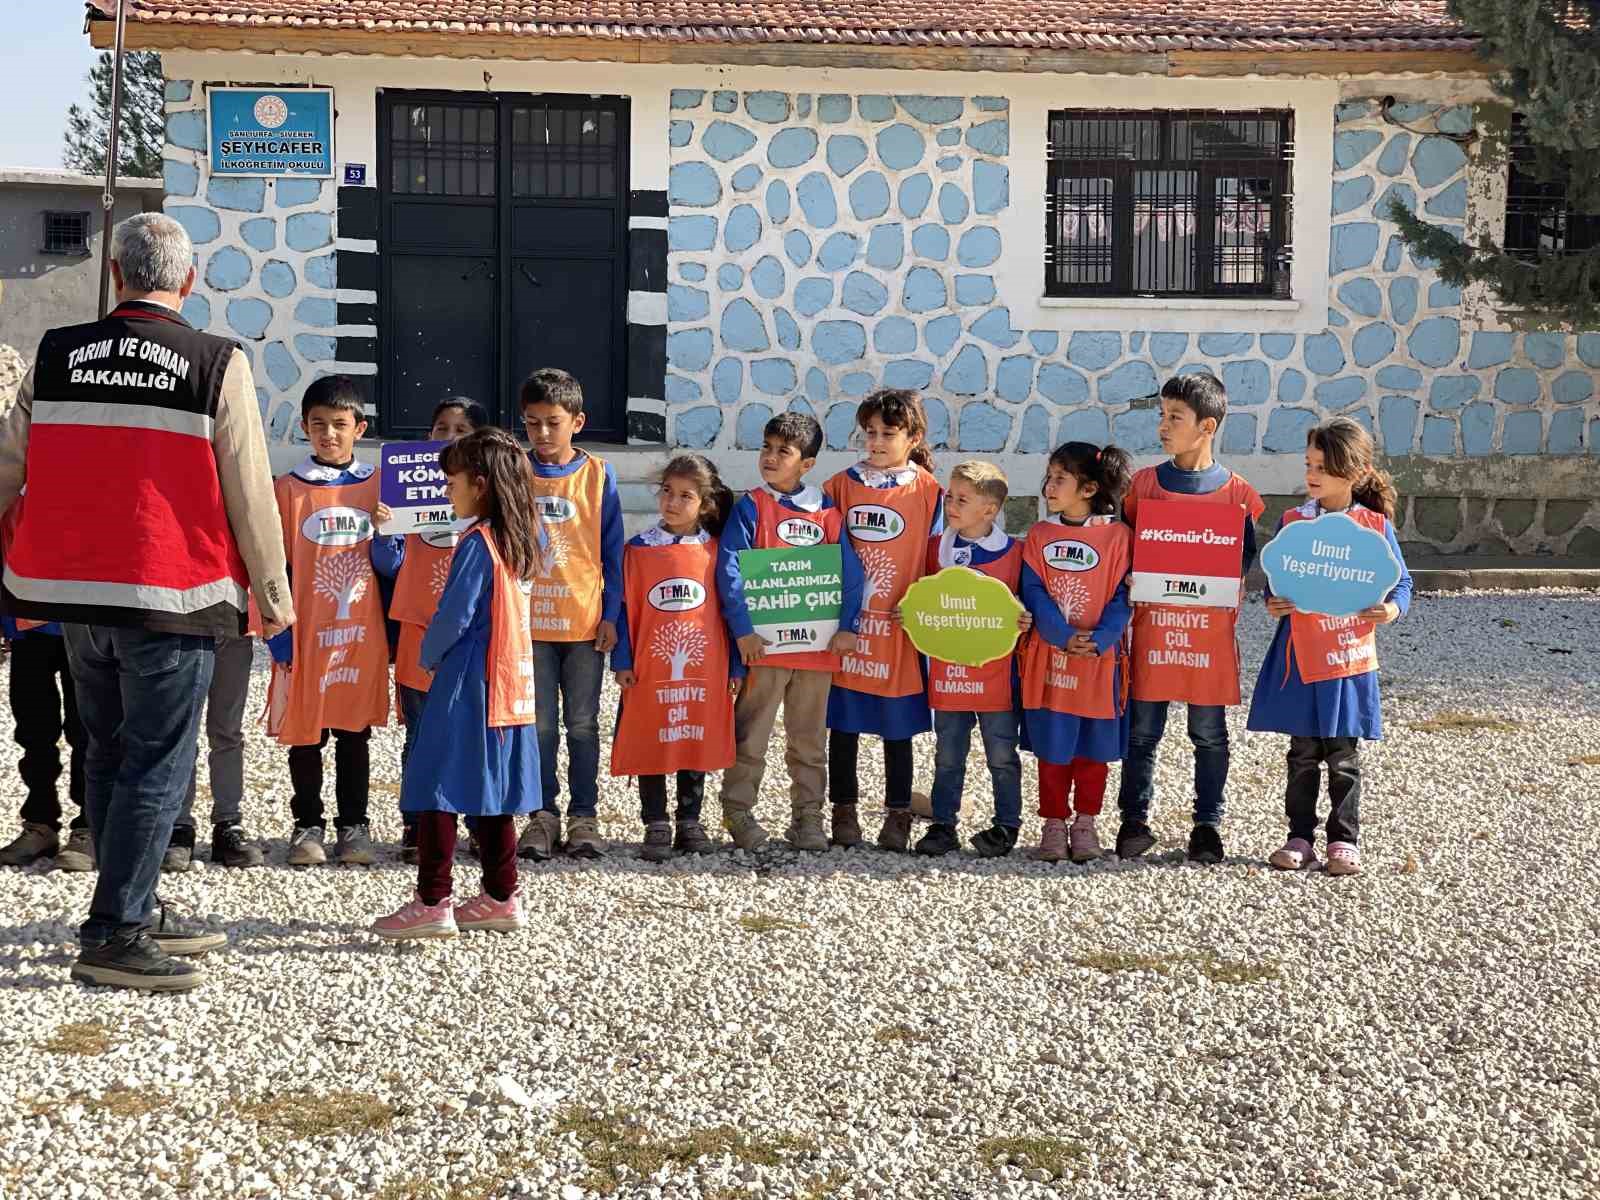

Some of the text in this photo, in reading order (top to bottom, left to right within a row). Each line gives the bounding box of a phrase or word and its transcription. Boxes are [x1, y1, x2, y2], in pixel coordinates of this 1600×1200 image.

[221, 141, 323, 157] ŞEYHCAFER
[288, 161, 324, 169] OKULU
[349, 169, 361, 179] 53
[68, 337, 190, 379] TARIM VE ORMAN
[71, 368, 176, 391] BAKANLIĞI
[388, 453, 440, 465] GELECE
[398, 465, 448, 484] KÖM
[406, 485, 449, 500] ETM
[319, 513, 357, 532] TEMA
[415, 511, 448, 522] TEMA
[854, 510, 886, 528] TEMA
[788, 523, 812, 537] TEMA
[1139, 528, 1237, 546] #KömürÜzer
[1054, 545, 1084, 560] TEMA
[1312, 539, 1352, 561] Umut
[770, 559, 811, 573] TARIM
[1281, 555, 1376, 584] Yeşertiyoruz
[744, 574, 840, 590] ALANLARIMIZA
[1165, 580, 1197, 594] TEMA
[660, 584, 691, 600] TEMA
[745, 589, 842, 612] SAHİP ÇIK!
[940, 593, 977, 610] Umut
[916, 611, 1003, 631] Yeşertiyoruz
[1150, 609, 1209, 629] TÜRKİYE
[777, 628, 808, 643] TEMA
[1165, 629, 1192, 648] ÇÖL
[856, 634, 872, 655] ÖL
[842, 655, 889, 679] MASIN
[1148, 650, 1210, 668] OLMASIN
[935, 679, 984, 694] OLMASIN
